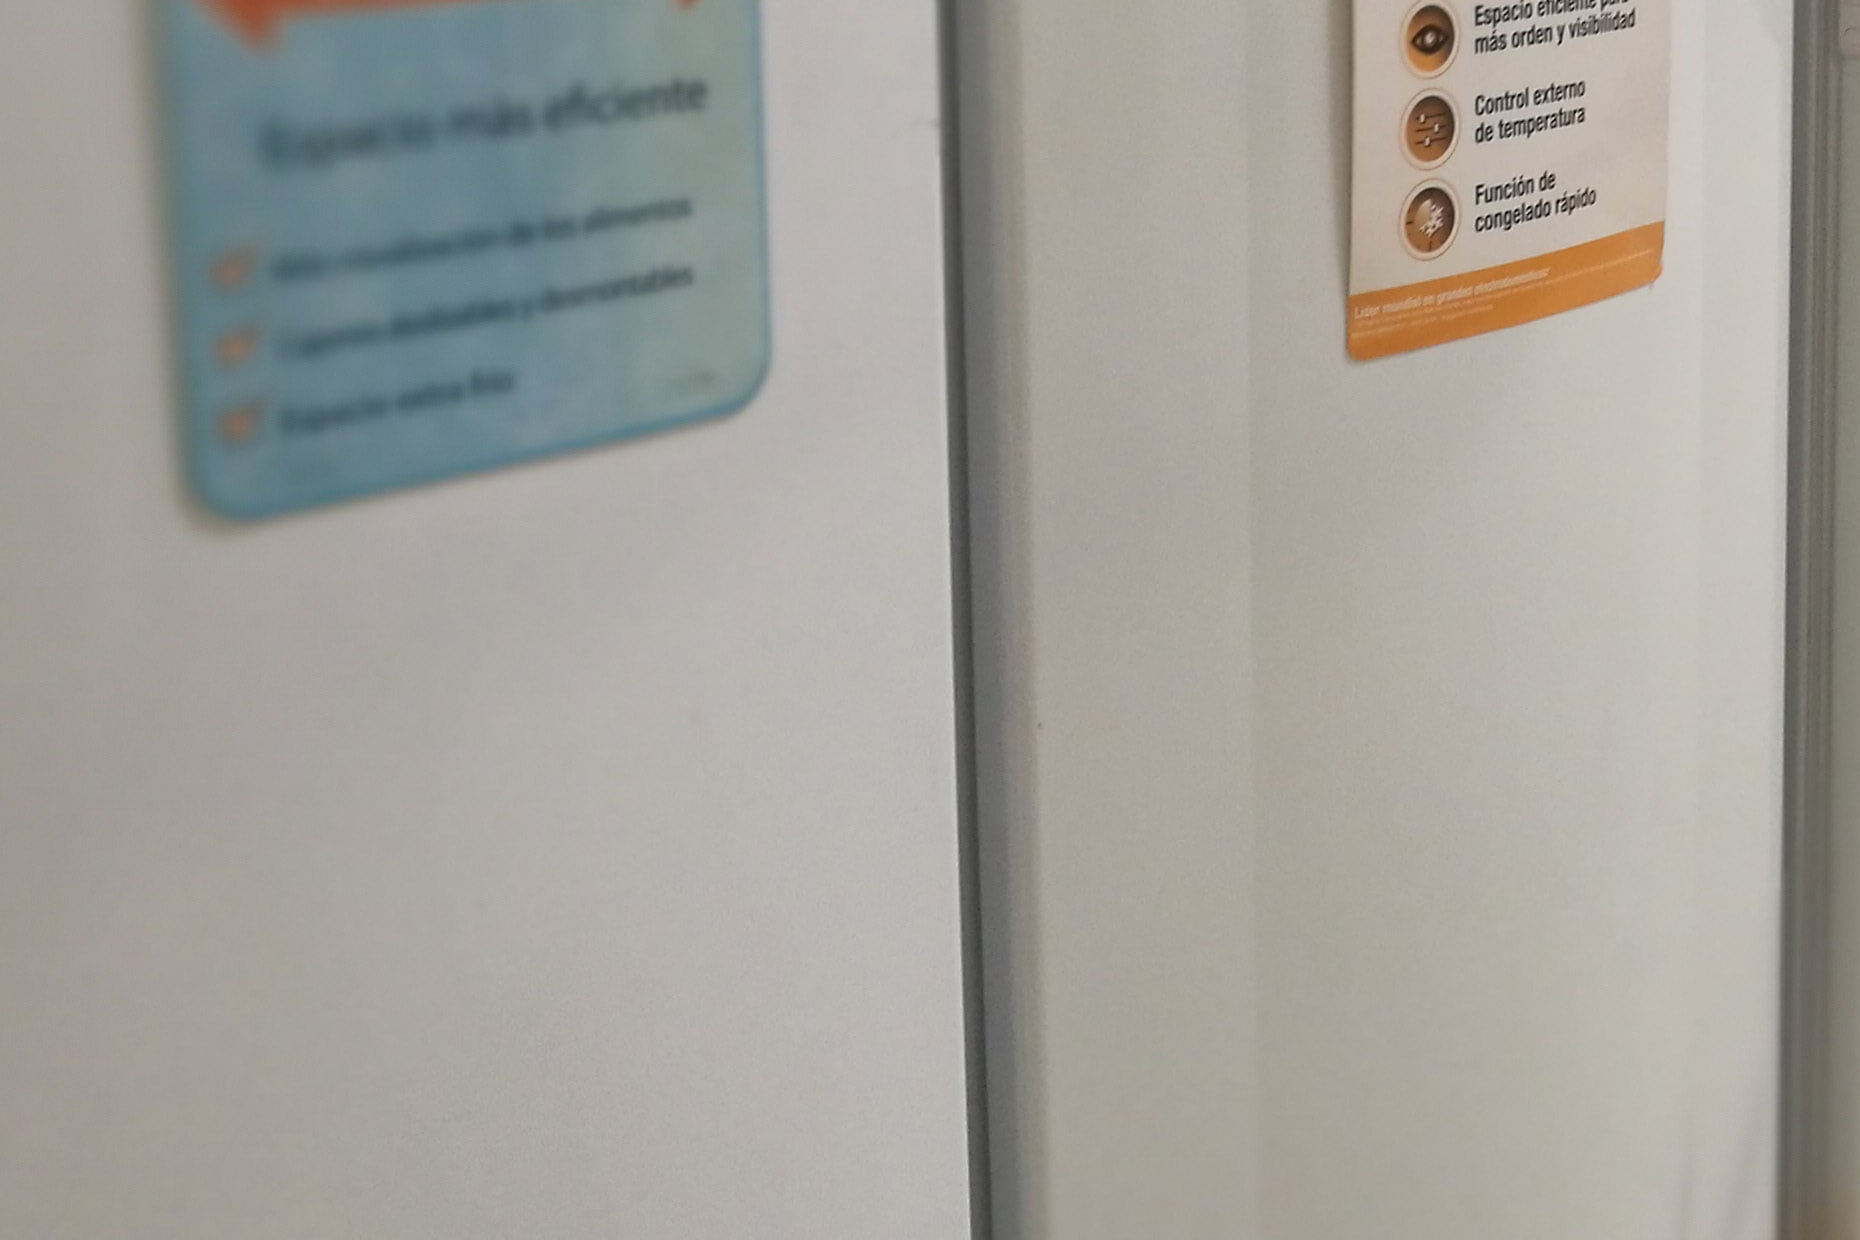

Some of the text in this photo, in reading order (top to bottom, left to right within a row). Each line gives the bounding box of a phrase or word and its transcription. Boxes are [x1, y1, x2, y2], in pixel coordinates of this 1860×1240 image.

[1475, 8, 1636, 54] más orden y visibilidad
[450, 94, 535, 144] más
[541, 77, 707, 131] eficiente
[1475, 79, 1586, 116] Control externo
[1475, 105, 1586, 144] de temperatura
[1475, 170, 1556, 206] Función de
[1475, 186, 1597, 233] congelado rápido
